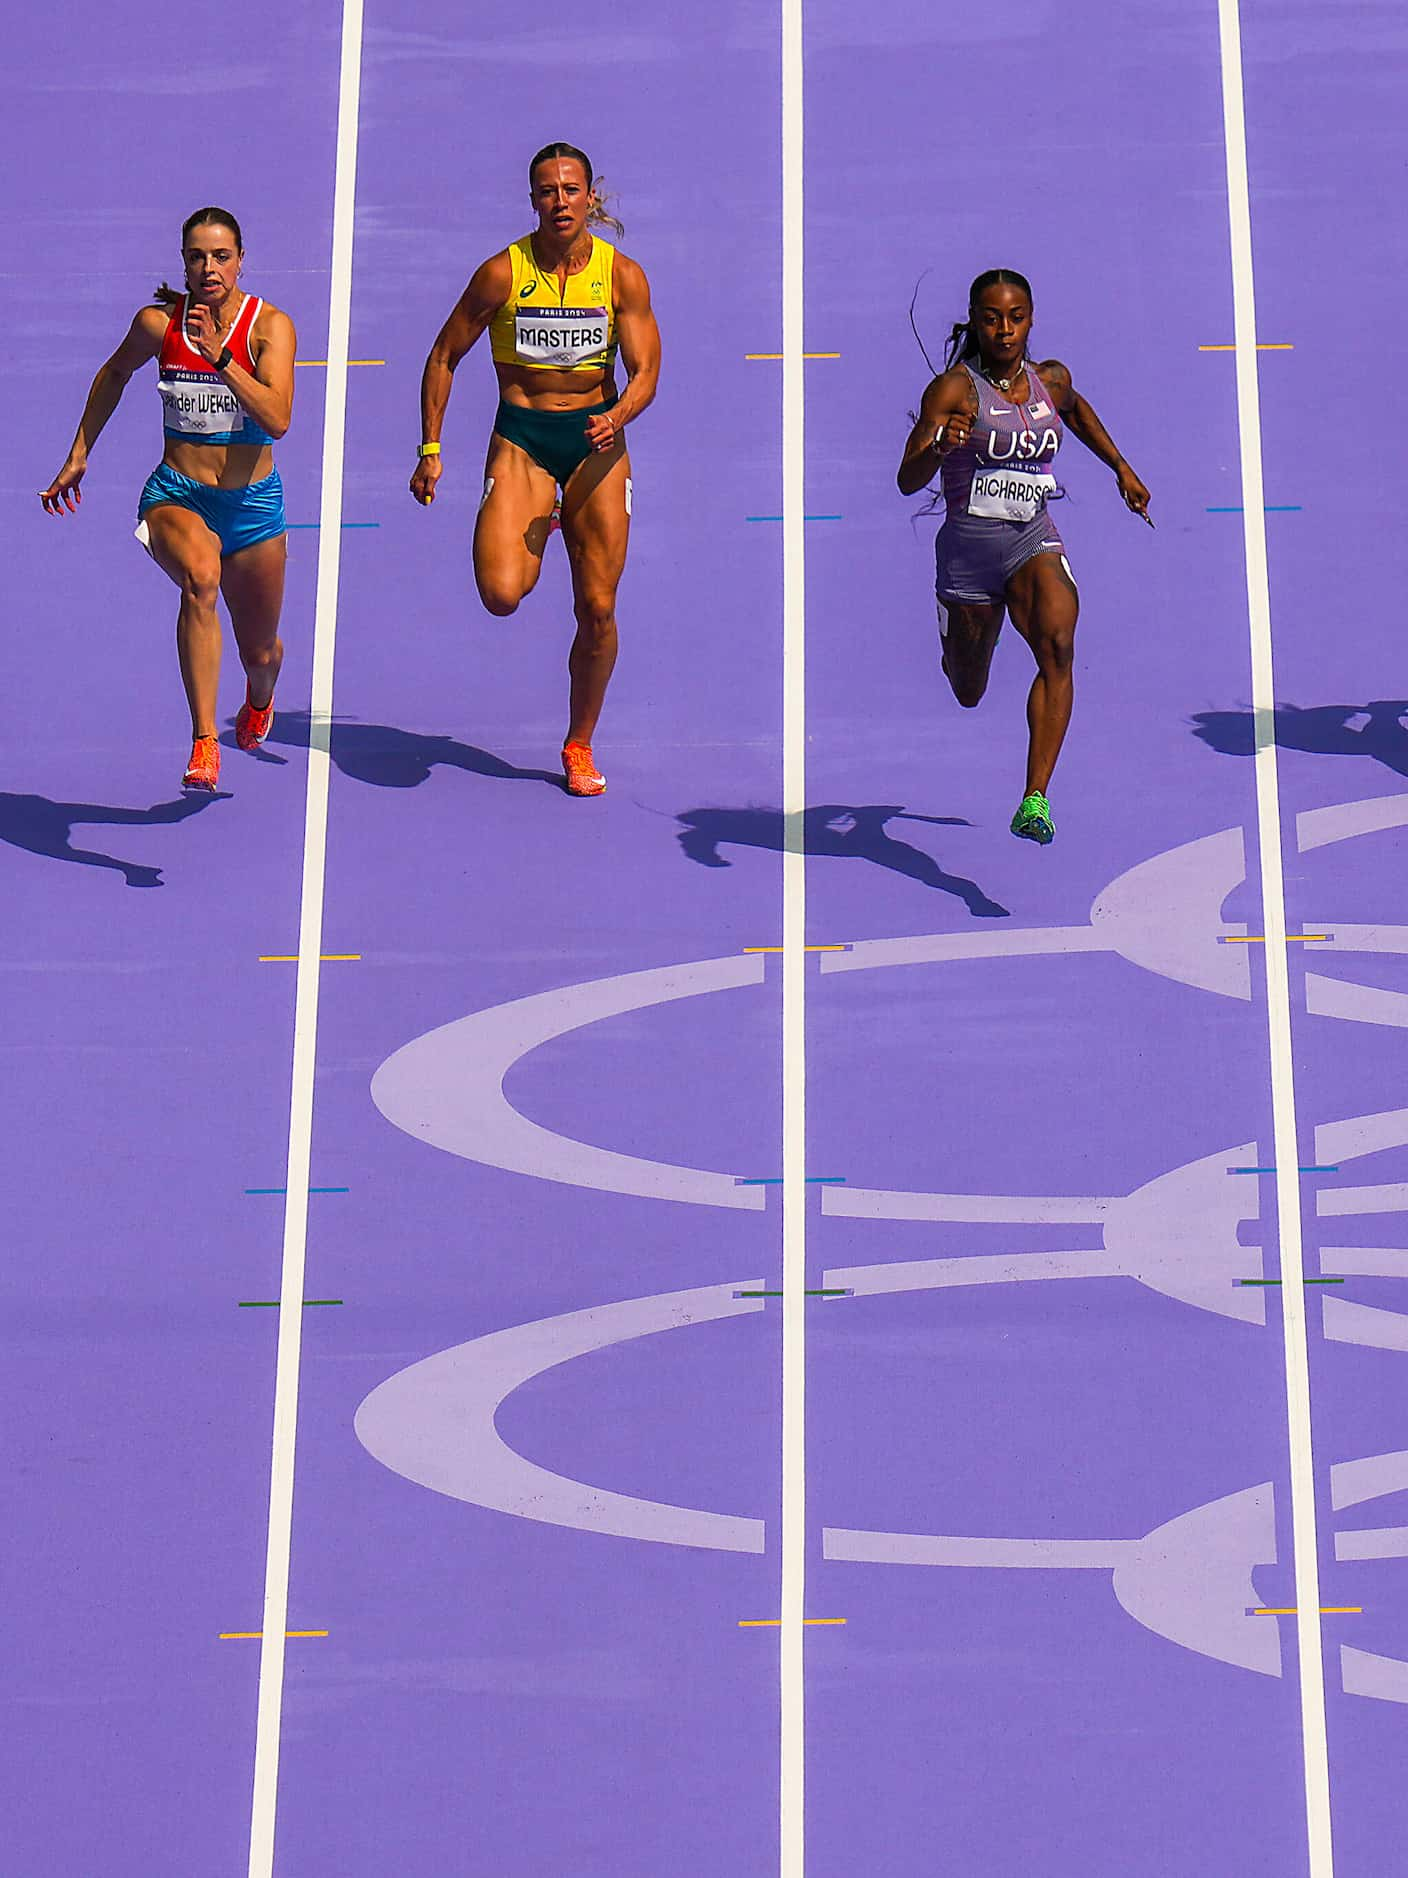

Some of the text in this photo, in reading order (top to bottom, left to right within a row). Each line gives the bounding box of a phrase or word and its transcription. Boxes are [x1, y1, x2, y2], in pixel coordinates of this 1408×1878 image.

[539, 308, 563, 317] PARIS
[520, 327, 603, 348] MASTERS
[175, 372, 198, 380] PARIS
[177, 392, 195, 413] der
[198, 393, 239, 414] WEKEN
[987, 428, 1059, 460] USA
